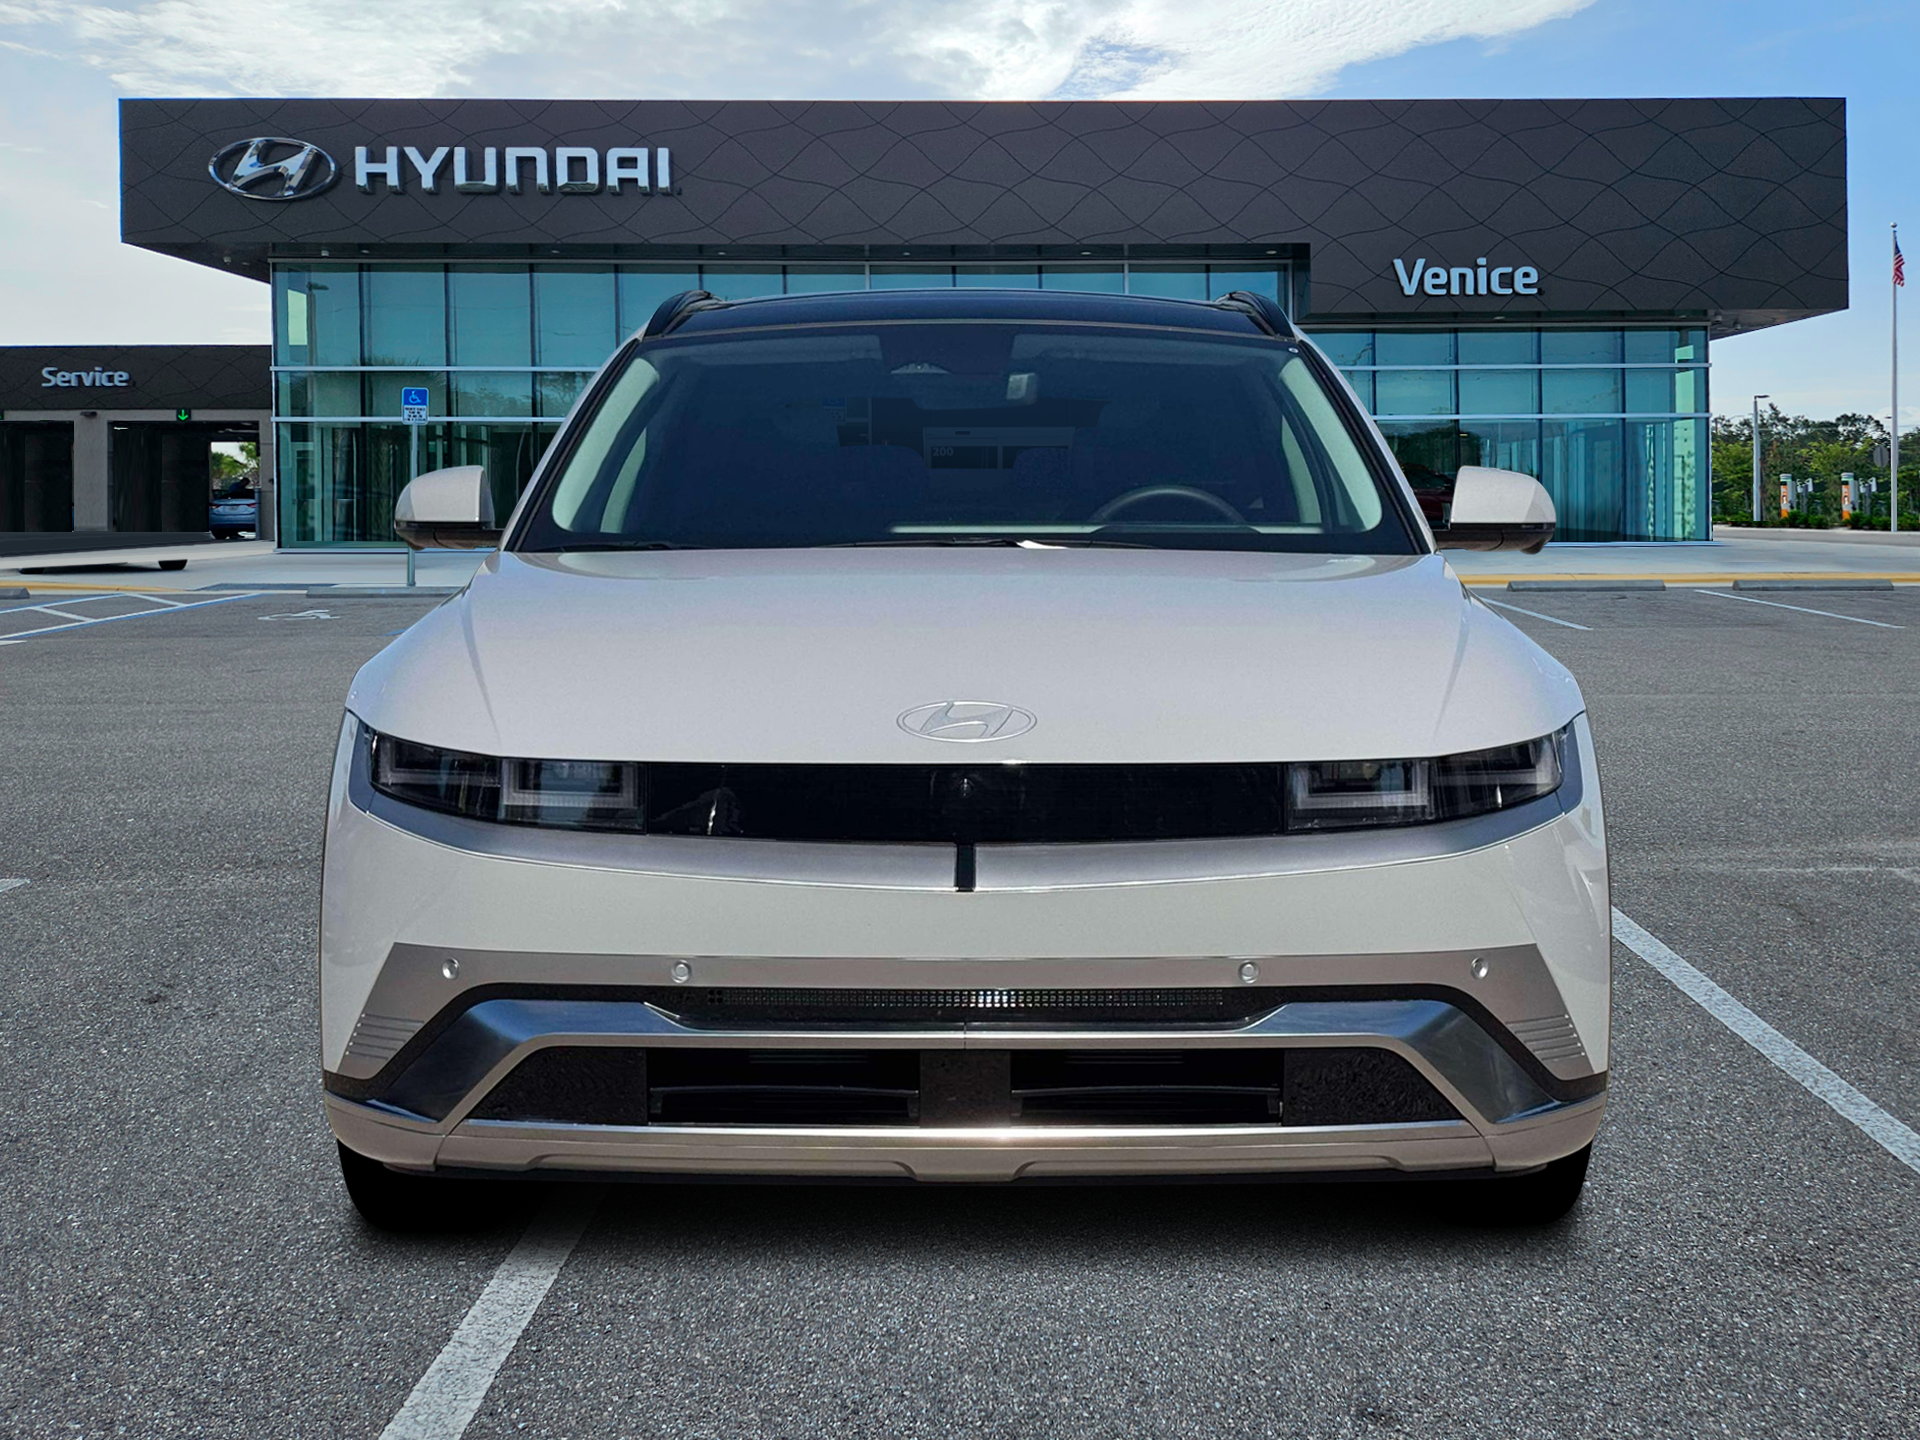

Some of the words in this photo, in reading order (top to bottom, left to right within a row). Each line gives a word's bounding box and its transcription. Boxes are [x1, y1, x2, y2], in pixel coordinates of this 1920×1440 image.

[354, 146, 670, 194] HYUNDAI
[1393, 257, 1539, 296] Venice
[41, 367, 130, 387] Service
[932, 446, 955, 457] 200
